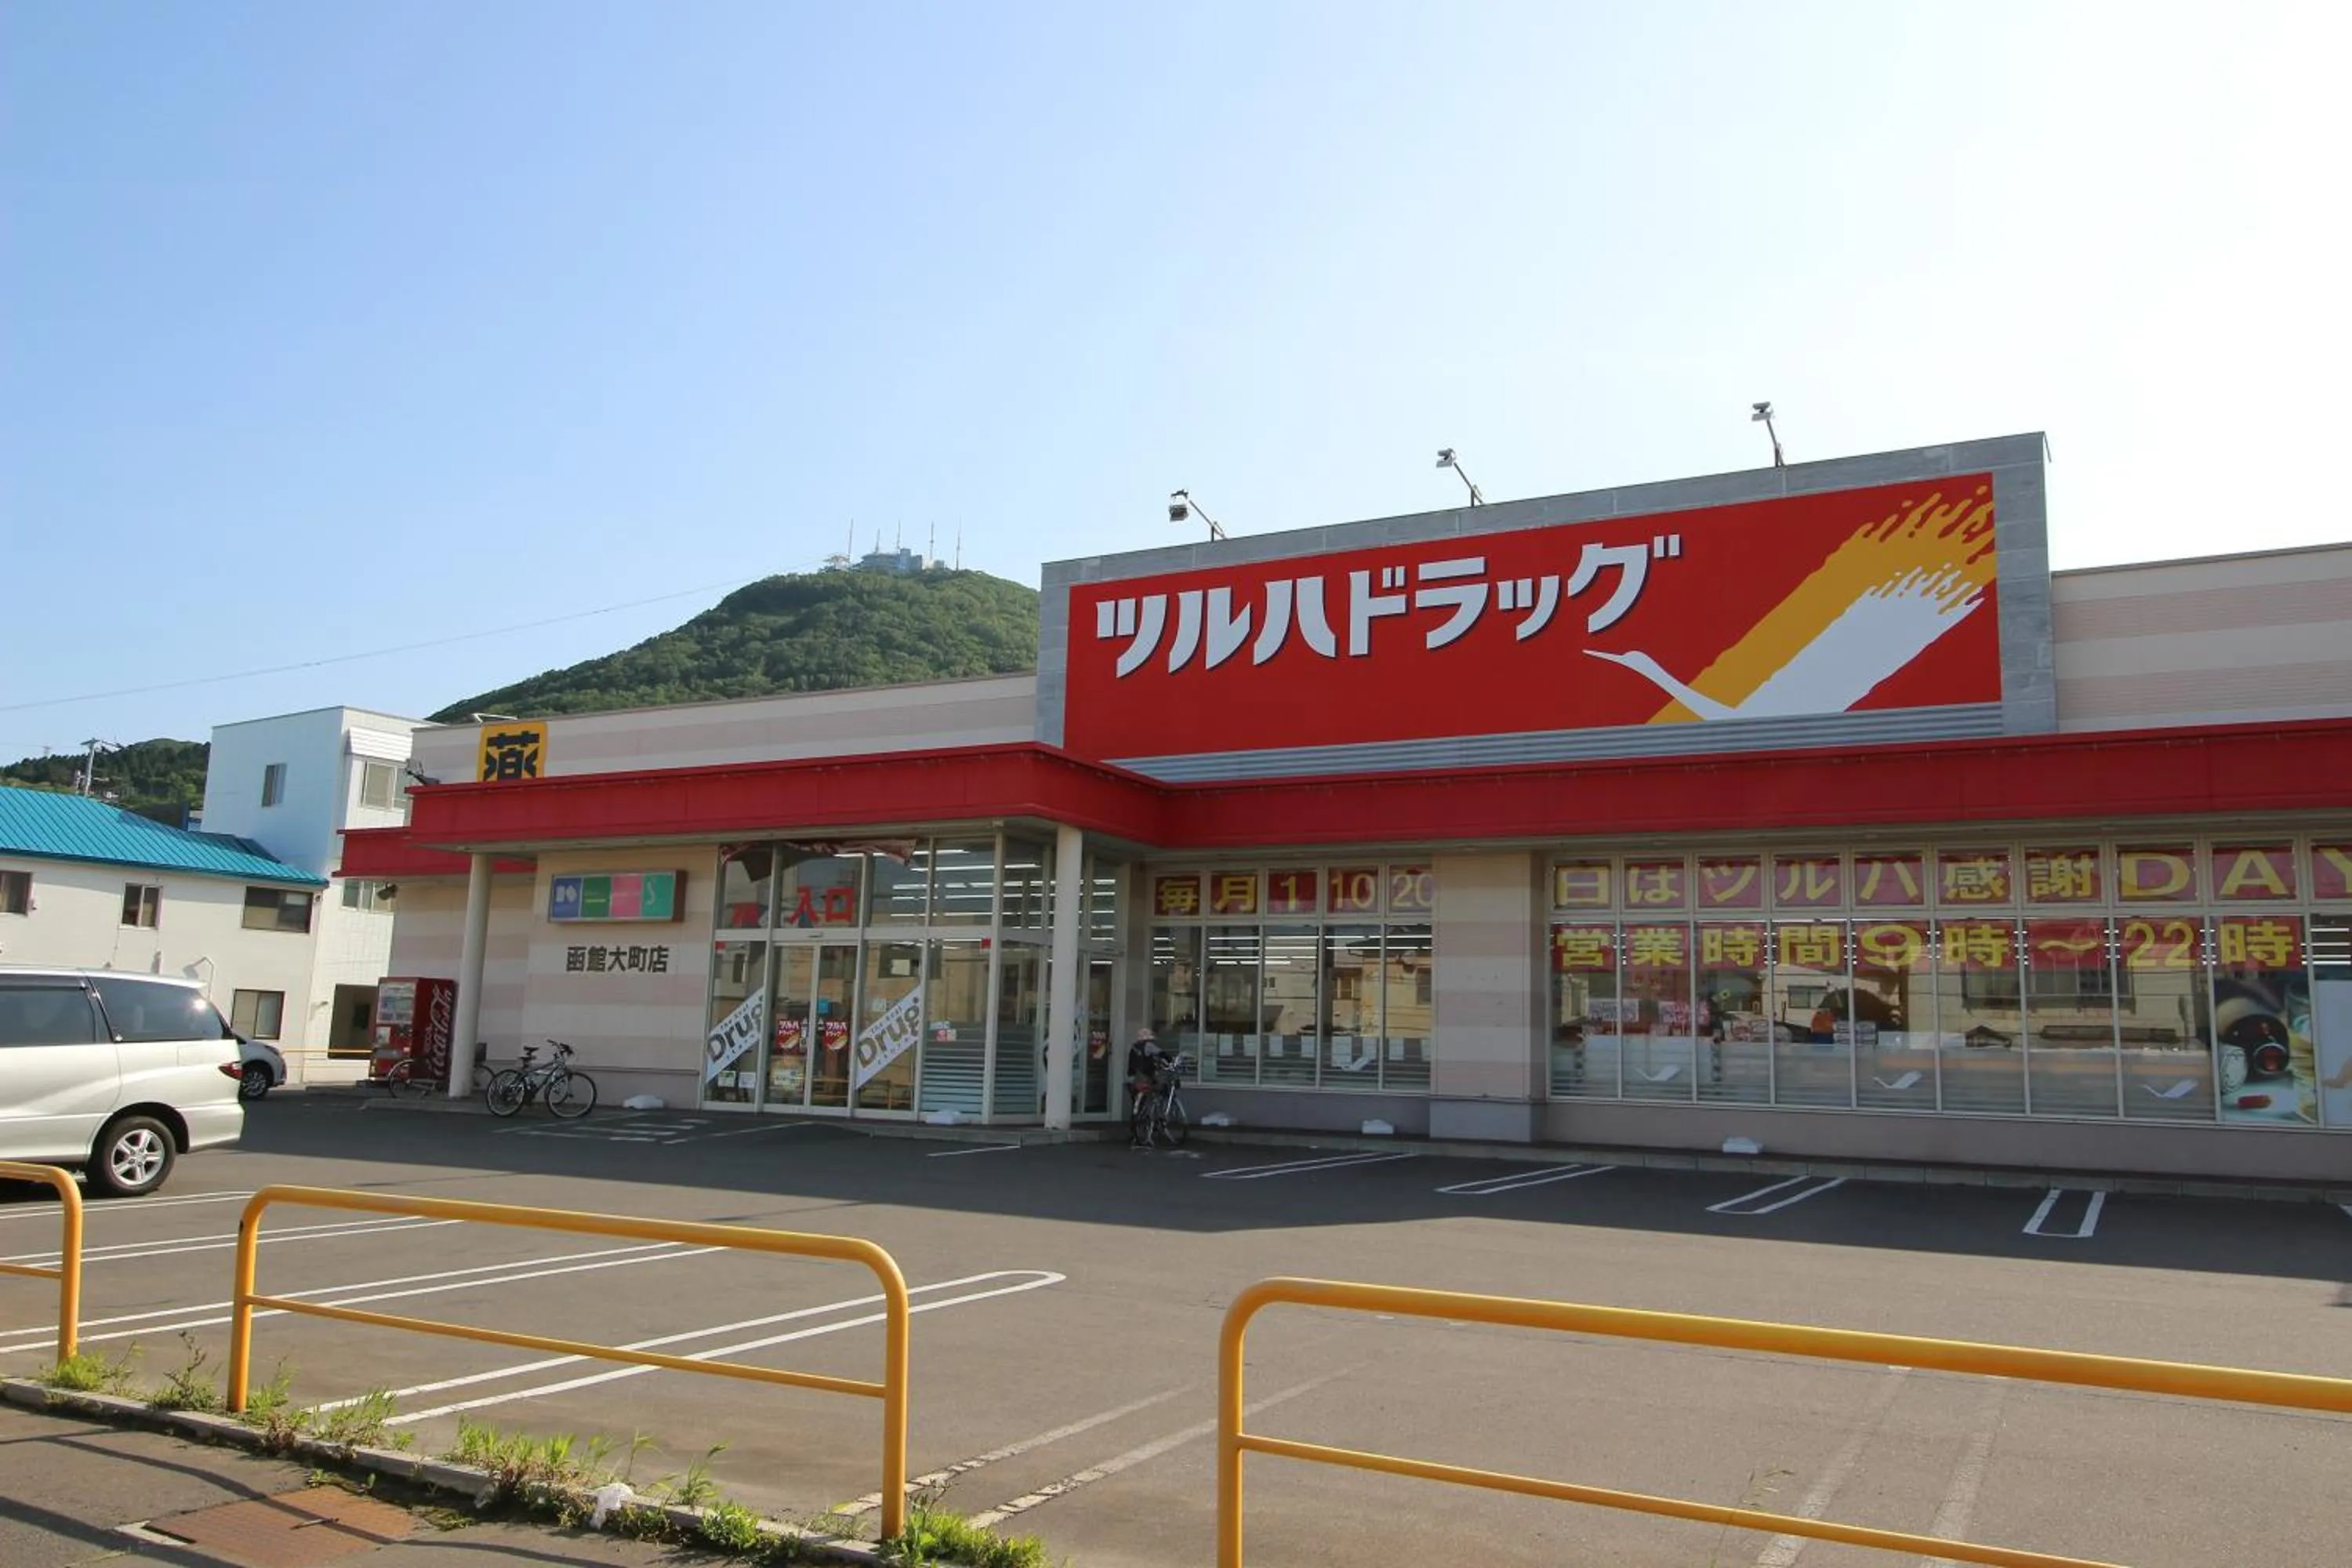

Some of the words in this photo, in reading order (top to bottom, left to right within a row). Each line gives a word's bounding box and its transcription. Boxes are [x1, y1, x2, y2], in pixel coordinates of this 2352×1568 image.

[1095, 534, 1681, 679] ツルハドラッグ
[483, 730, 540, 781] 薬
[789, 885, 855, 925] 入口
[565, 945, 670, 974] 函館大町店
